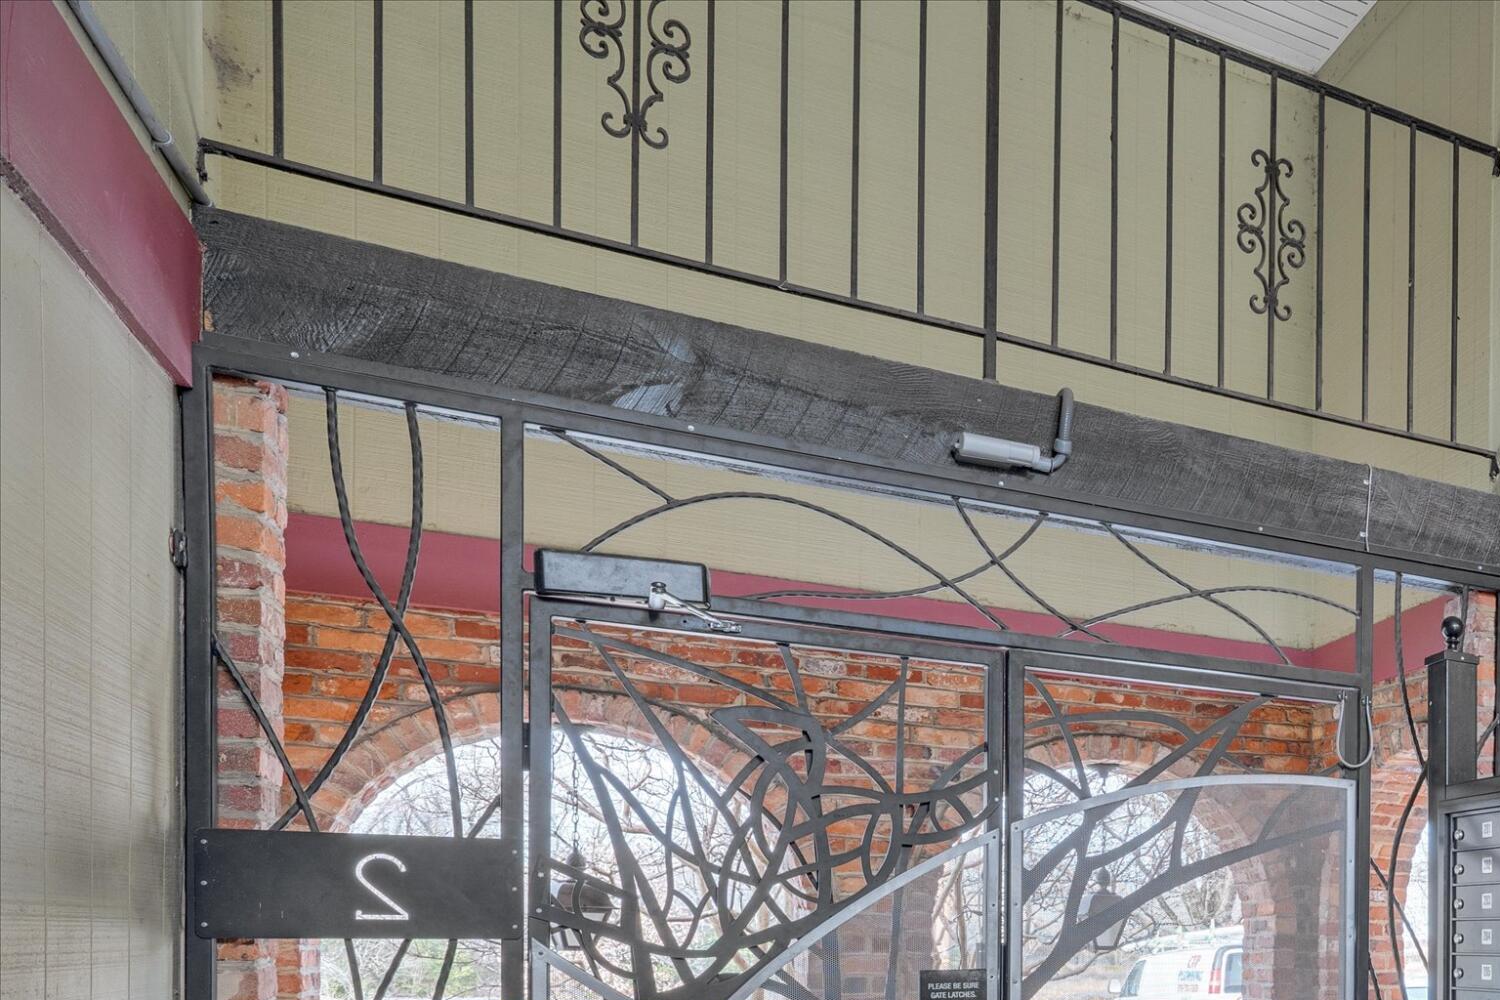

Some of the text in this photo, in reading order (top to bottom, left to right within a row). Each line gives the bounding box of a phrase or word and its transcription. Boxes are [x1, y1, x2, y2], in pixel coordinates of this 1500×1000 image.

[928, 982, 952, 990] PLEASE
[952, 982, 962, 990] BE
[930, 991, 946, 999] GATE
